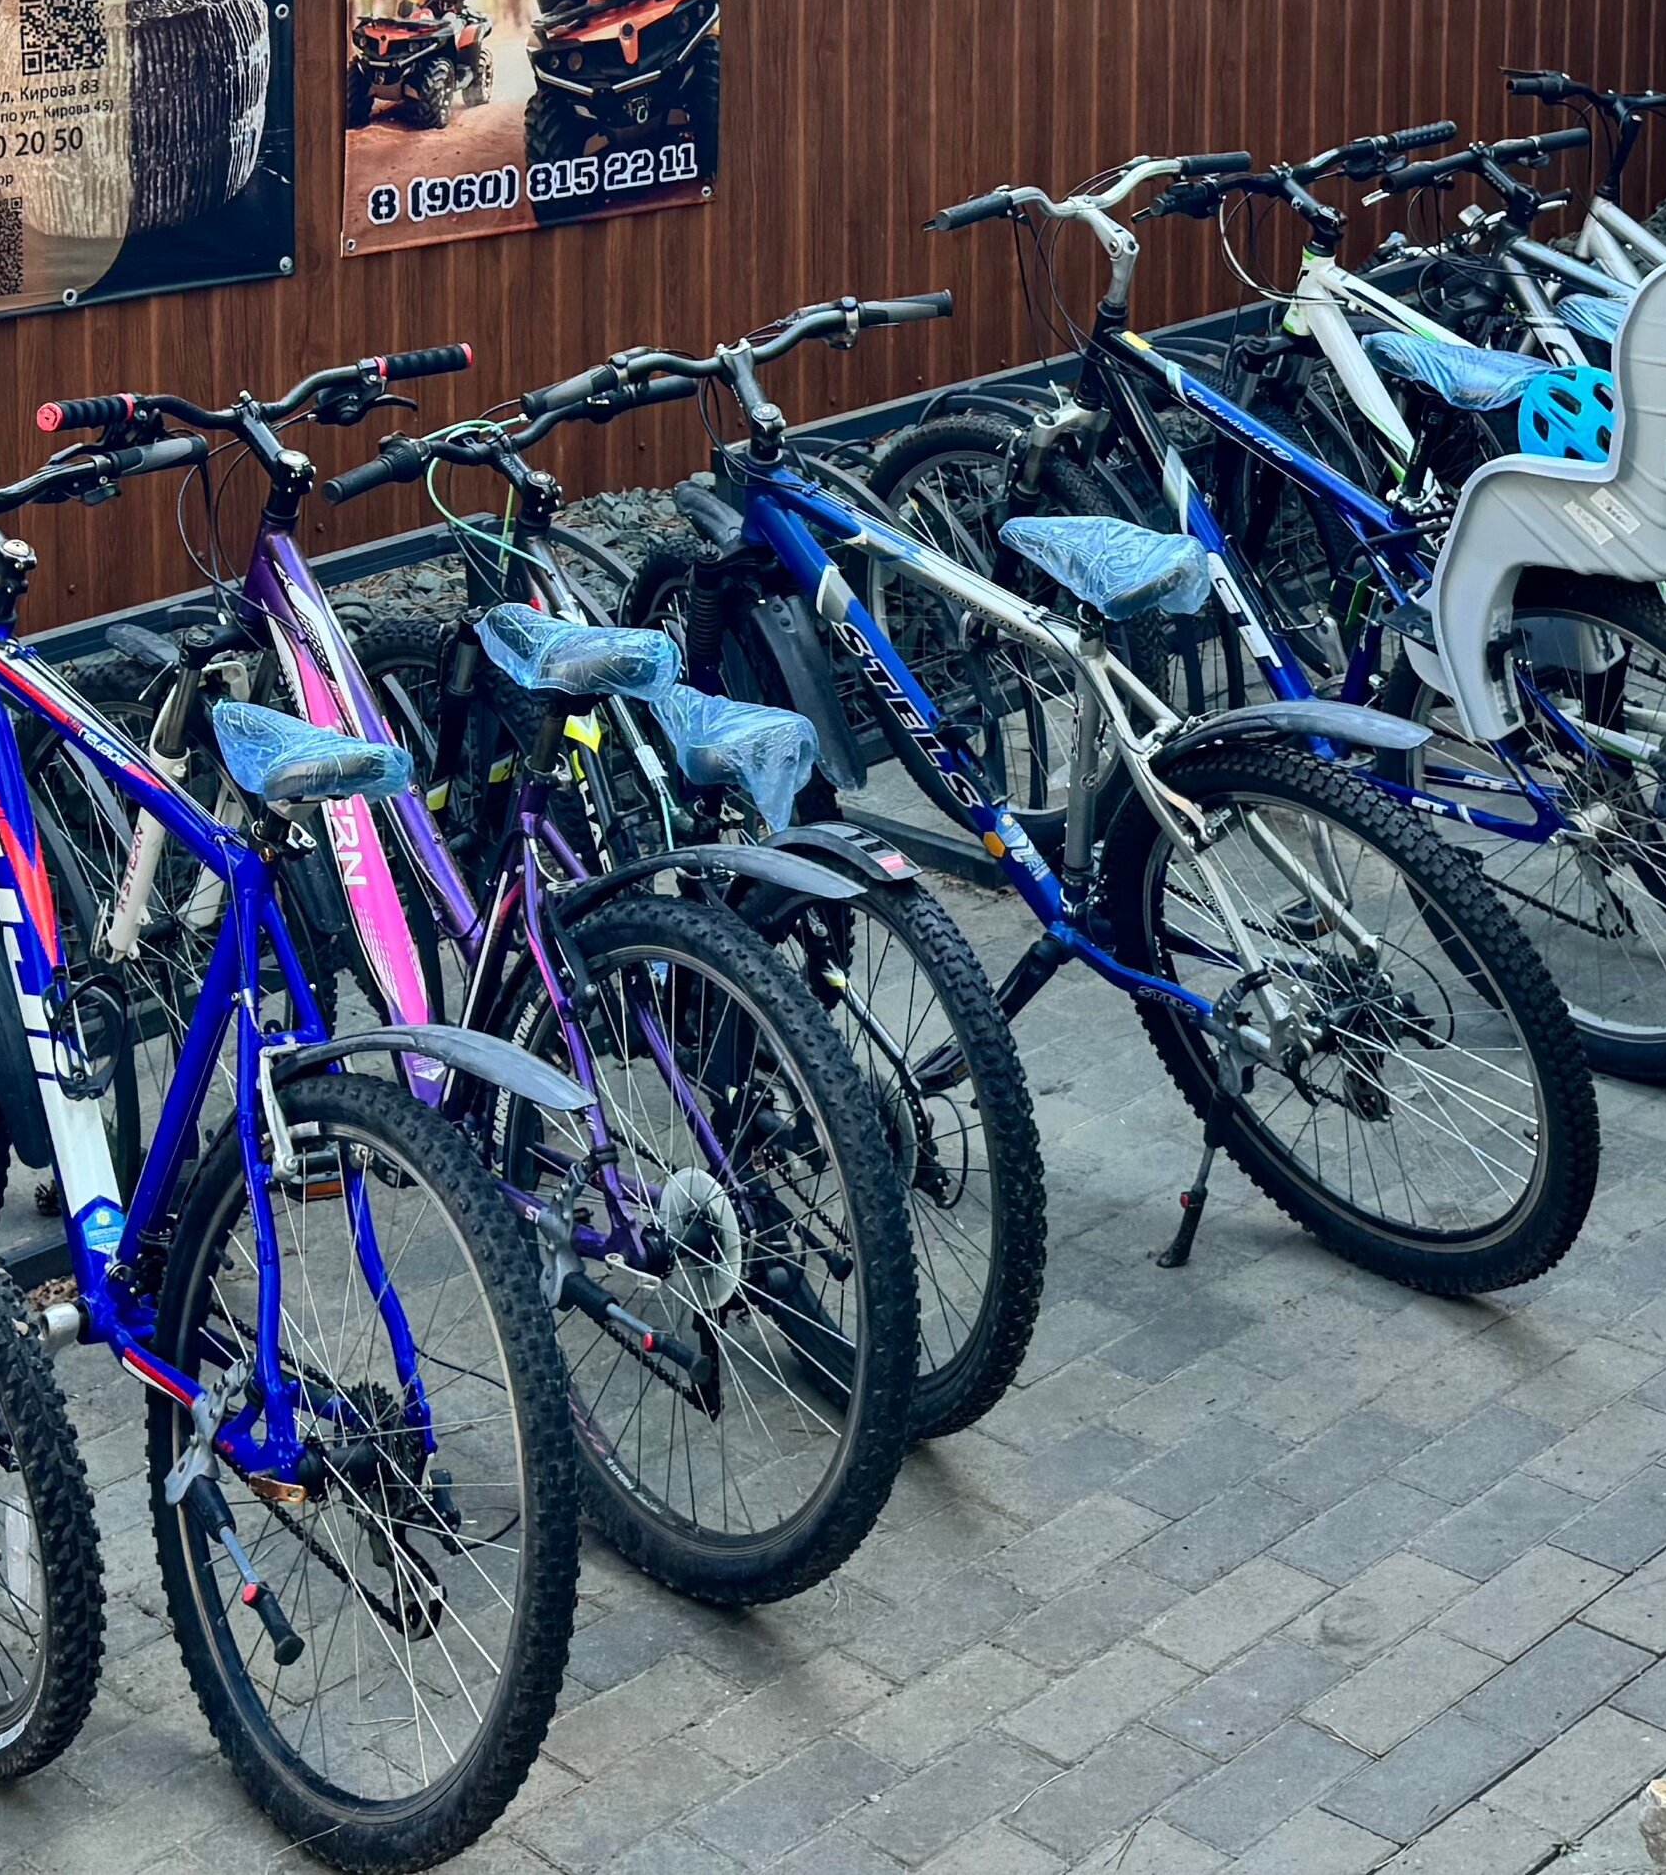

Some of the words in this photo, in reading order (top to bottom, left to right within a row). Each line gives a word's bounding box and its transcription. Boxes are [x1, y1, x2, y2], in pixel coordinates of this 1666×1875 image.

[19, 83, 77, 104] Кирова
[80, 79, 100, 95] 83
[0, 112, 17, 125] по
[20, 110, 40, 124] ул.
[43, 103, 91, 122] Кирова
[93, 99, 114, 114] 45)
[15, 130, 46, 158] 20
[53, 125, 84, 153] 50
[368, 184, 399, 224] 8
[408, 166, 520, 222] (960)
[526, 156, 599, 202] 815
[604, 149, 654, 191] 22
[659, 142, 698, 183] 11
[831, 620, 985, 809] STELS
